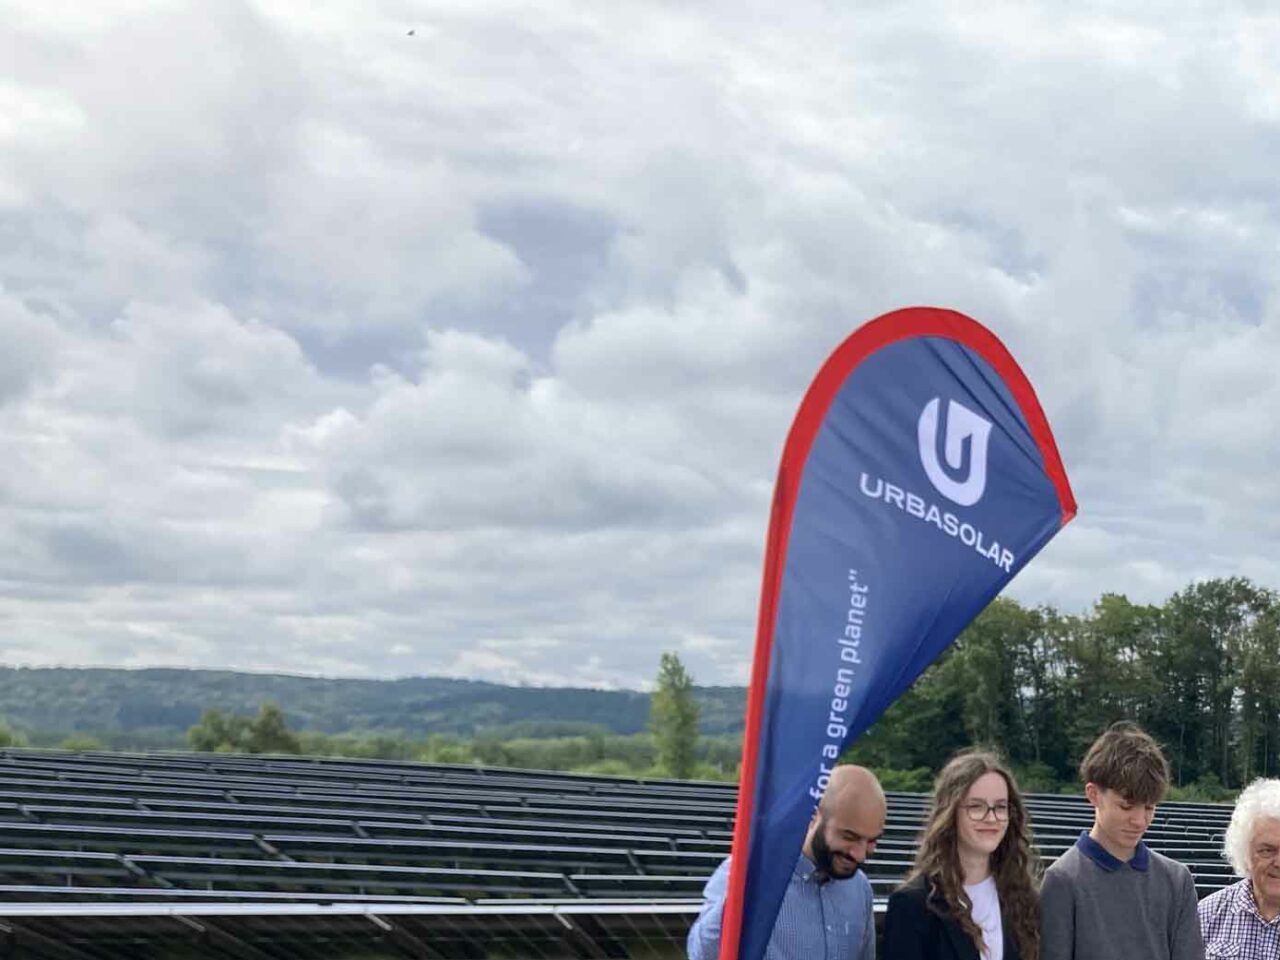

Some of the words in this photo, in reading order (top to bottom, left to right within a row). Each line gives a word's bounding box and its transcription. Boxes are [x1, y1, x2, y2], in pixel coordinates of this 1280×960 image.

[860, 472, 1015, 573] URBASOLAR
[826, 667, 855, 739] green
[822, 743, 839, 760] a
[809, 763, 834, 800] for
